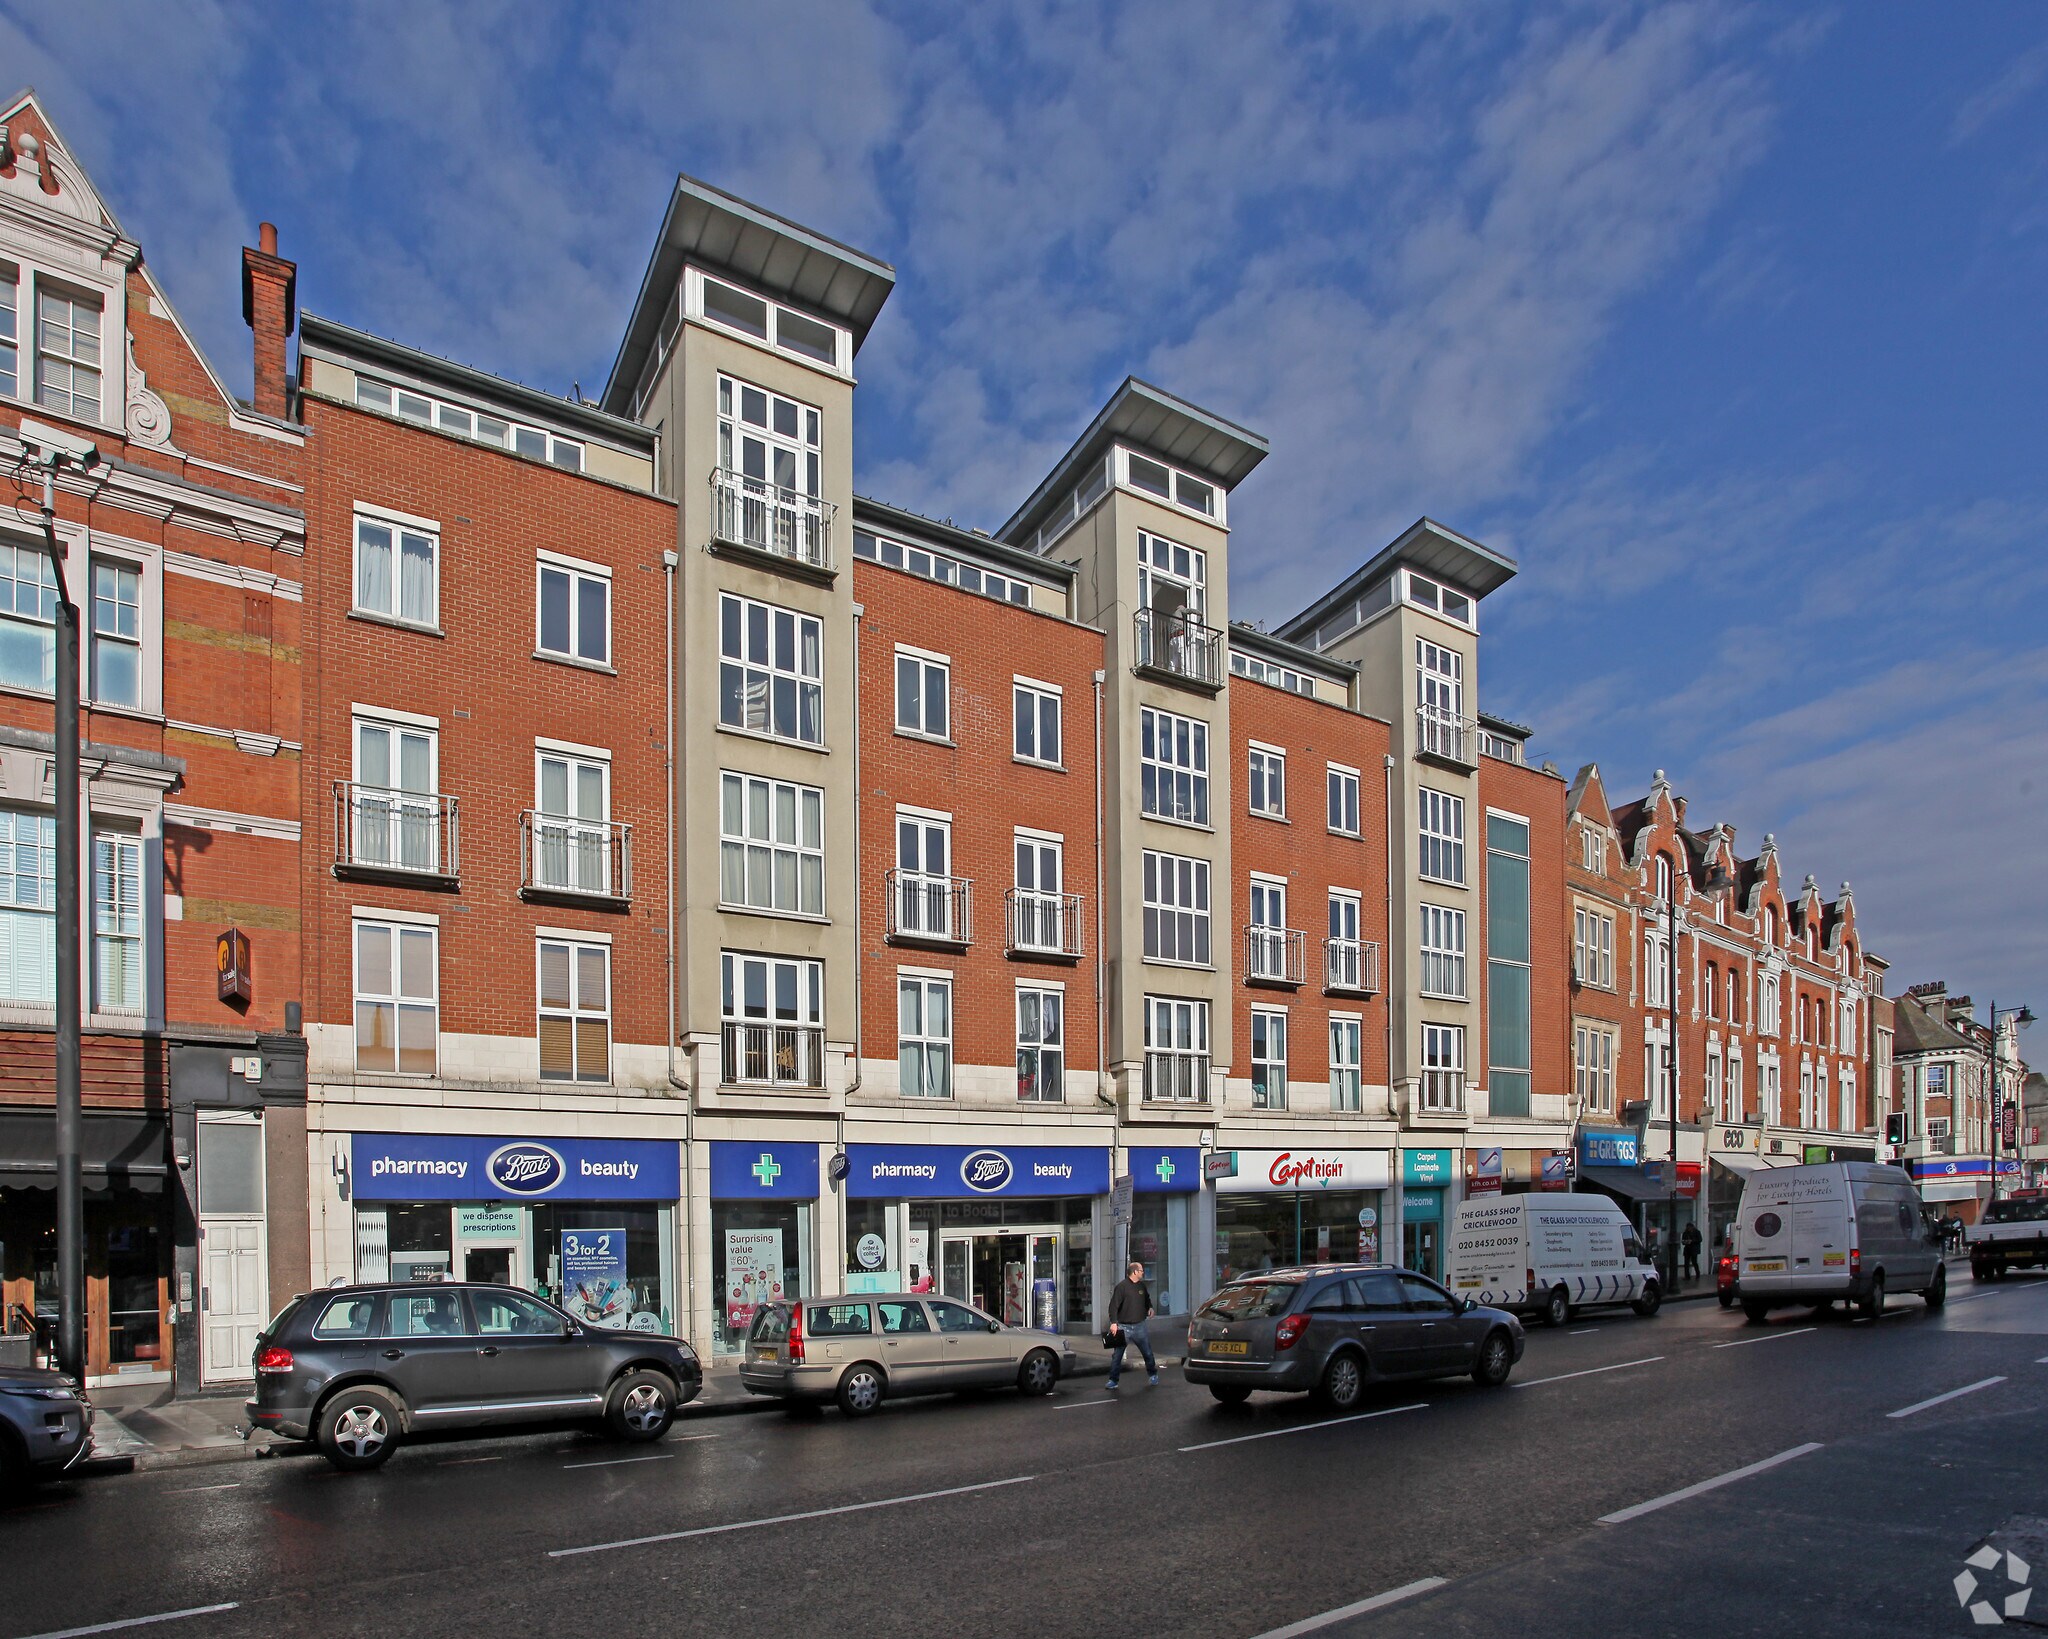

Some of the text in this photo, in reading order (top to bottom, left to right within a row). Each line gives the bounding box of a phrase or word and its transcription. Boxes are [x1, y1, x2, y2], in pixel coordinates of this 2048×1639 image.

[2004, 1108, 2014, 1143] INFERNOS
[1598, 1140, 1635, 1160] GREGGS
[1417, 1152, 1437, 1162] Carpet
[372, 1154, 639, 1181] pharmacy Boots beauty
[873, 1159, 1073, 1182] pharmacy Boots beauty
[1268, 1152, 1315, 1187] Carpet
[1413, 1163, 1440, 1172] Laminate
[1420, 1174, 1434, 1183] Vinyl
[1471, 1179, 1498, 1188] kfh.co.uk
[1676, 1176, 1695, 1188] antander
[1758, 1176, 1829, 1191] Luxury Products
[1757, 1185, 1833, 1202] for Luxury Hotels
[1403, 1197, 1434, 1207] Welcome
[946, 1205, 960, 1217] to
[963, 1203, 1000, 1218] Boots
[1461, 1206, 1521, 1219] THE GLASS SHOP
[476, 1212, 513, 1222] dispense
[1540, 1216, 1549, 1224] THE
[1549, 1216, 1565, 1224] GLASS
[463, 1223, 516, 1233] prescriptions
[1463, 1217, 1518, 1230] CRICKLEWOOD
[730, 1234, 774, 1244] Surprising
[909, 1235, 920, 1244] ice
[1458, 1236, 1519, 1250] 020 8452 0039
[565, 1235, 610, 1256] 3 for 2
[730, 1245, 753, 1254] value
